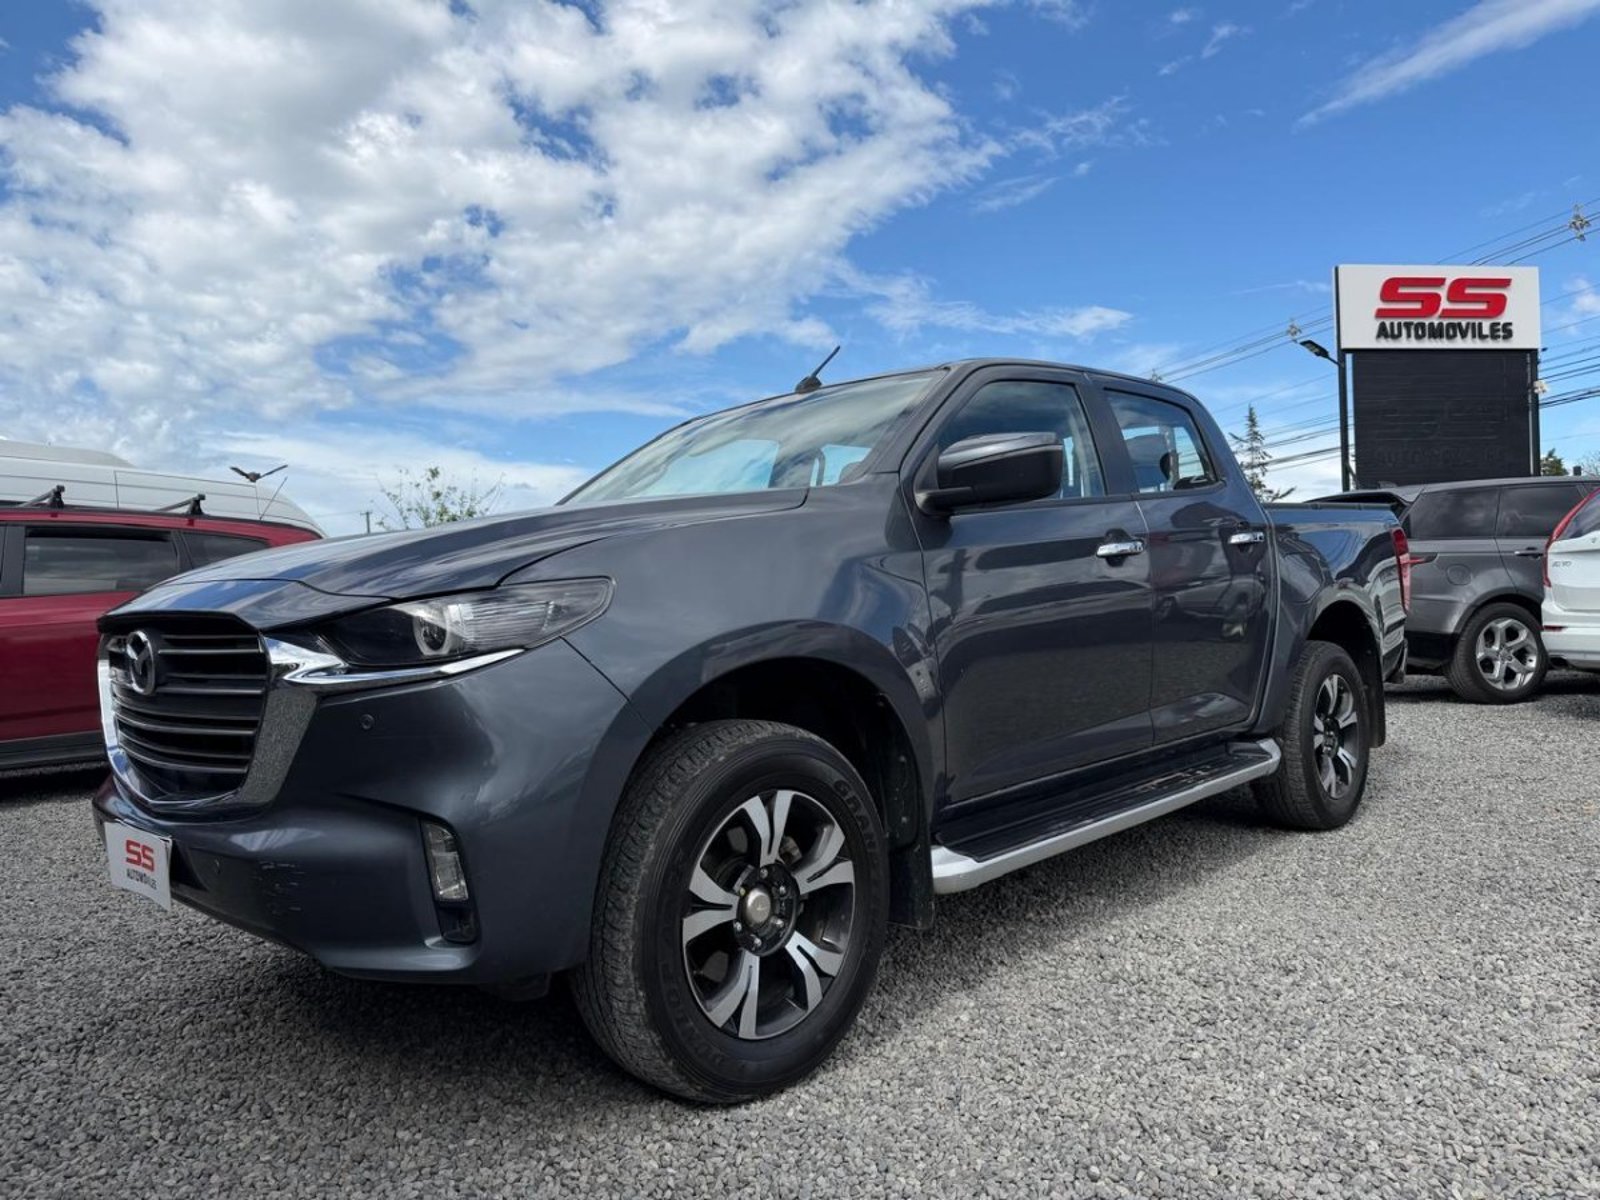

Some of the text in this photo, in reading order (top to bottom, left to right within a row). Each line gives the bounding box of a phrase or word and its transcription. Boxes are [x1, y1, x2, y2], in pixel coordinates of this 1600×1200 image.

[1374, 276, 1513, 319] SS
[1375, 321, 1514, 341] AUTOMOVILES
[126, 839, 155, 873] SS
